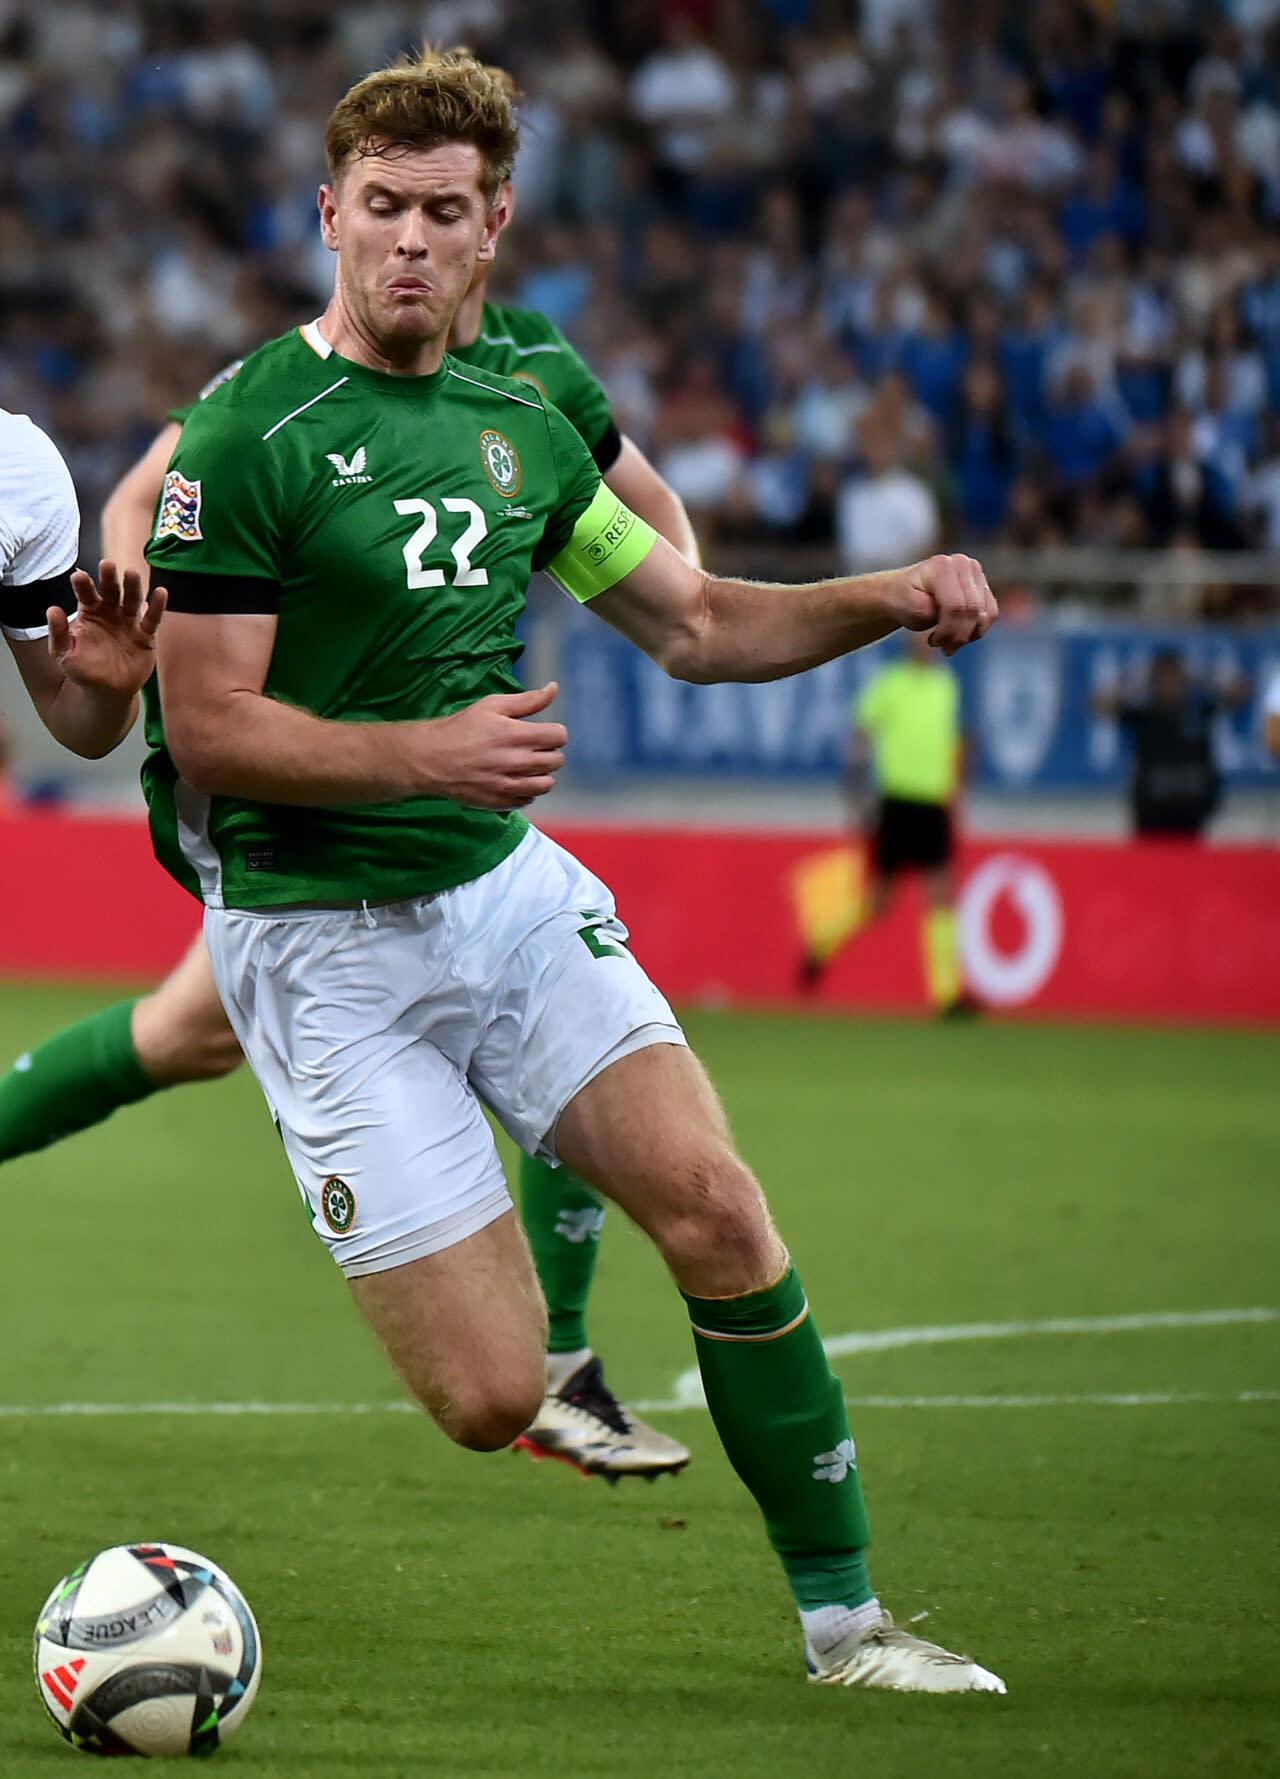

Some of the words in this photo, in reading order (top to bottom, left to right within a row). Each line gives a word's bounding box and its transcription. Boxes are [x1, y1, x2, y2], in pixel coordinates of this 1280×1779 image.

[481, 433, 514, 456] IRELAND
[393, 498, 489, 590] 22
[605, 510, 631, 545] RESP
[83, 1603, 166, 1642] LEAGUE
